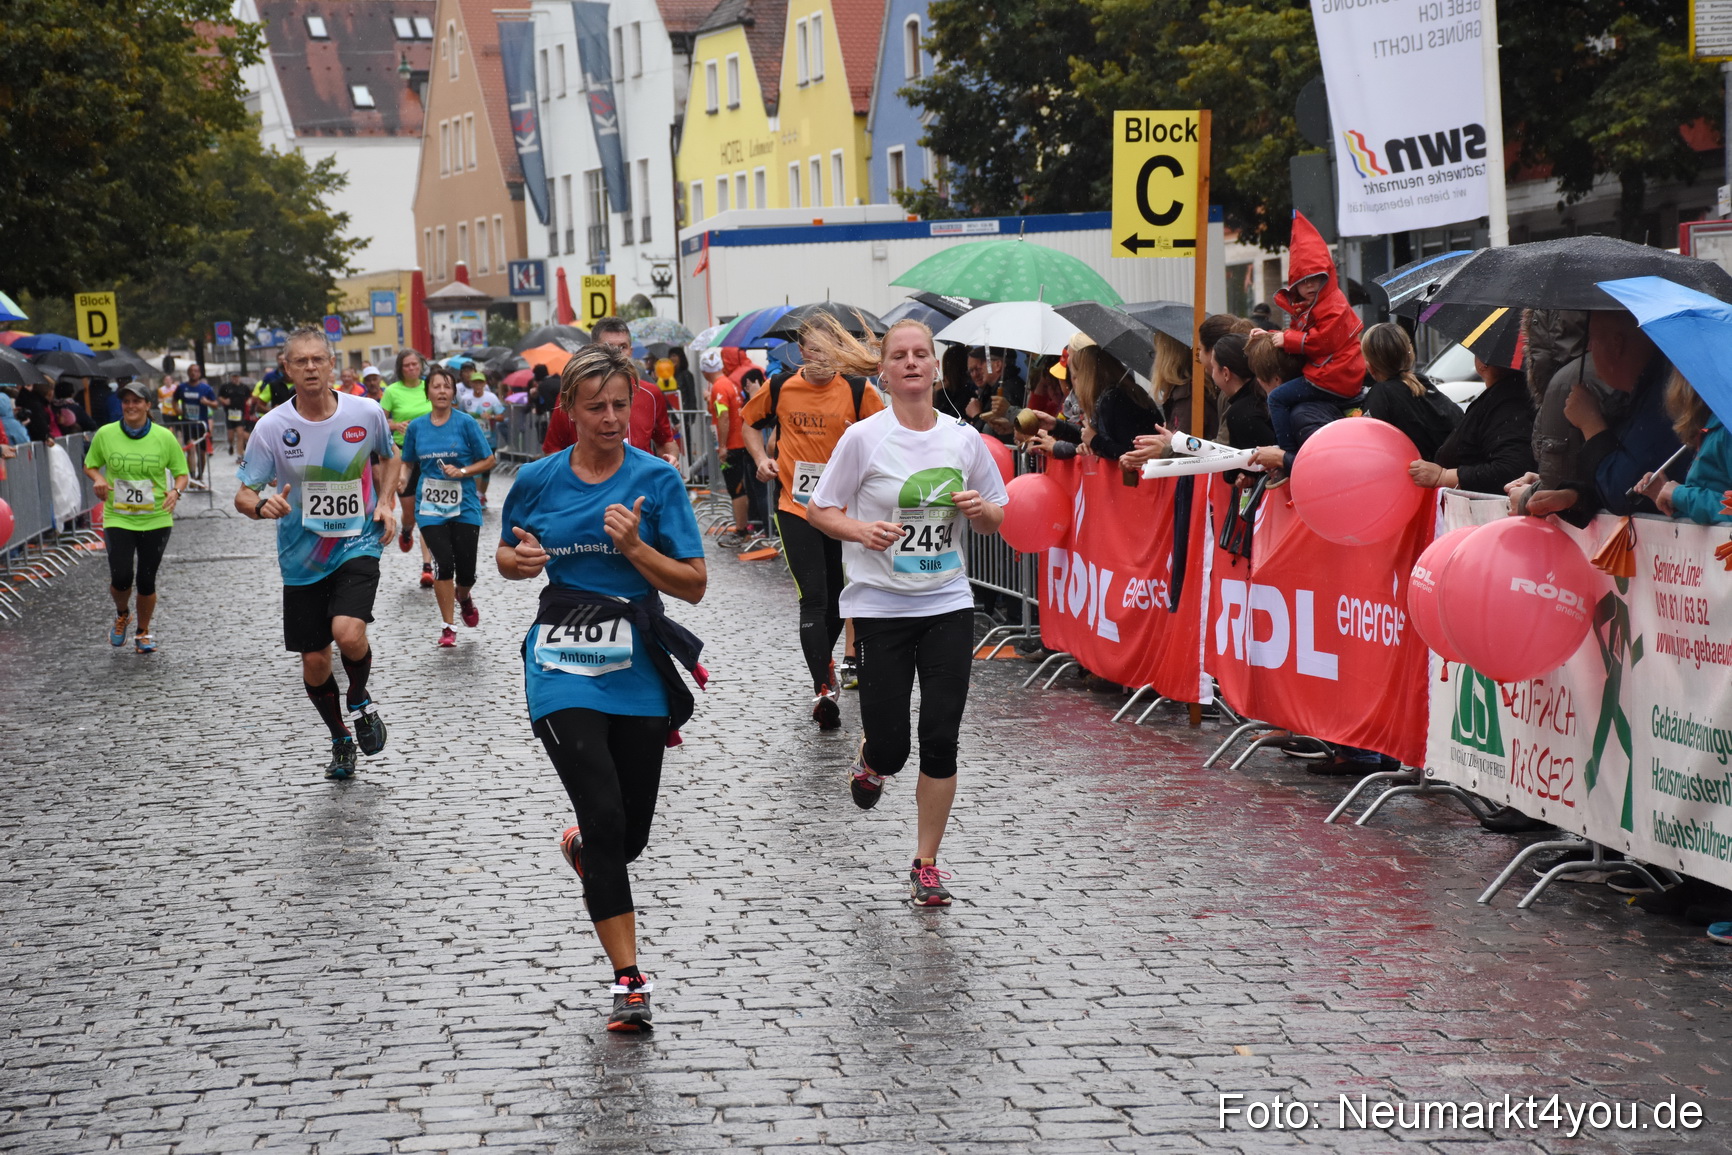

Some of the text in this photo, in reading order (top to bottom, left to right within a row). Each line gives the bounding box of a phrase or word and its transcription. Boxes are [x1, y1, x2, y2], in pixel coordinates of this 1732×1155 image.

[1126, 117, 1198, 143] Block
[720, 139, 743, 166] HOTEL
[1136, 154, 1185, 227] C
[584, 277, 611, 288] Block
[80, 295, 111, 307] Block
[590, 292, 607, 319] D
[87, 310, 108, 338] D
[799, 474, 821, 493] 27
[126, 489, 143, 503] 26
[309, 494, 359, 516] 2366
[425, 488, 459, 504] 2329
[323, 521, 346, 530] Heinz
[900, 522, 954, 552] 2434
[920, 559, 942, 571] Silke
[1684, 596, 1695, 624] 63
[1697, 598, 1710, 626] 52
[559, 652, 606, 664] Antonia
